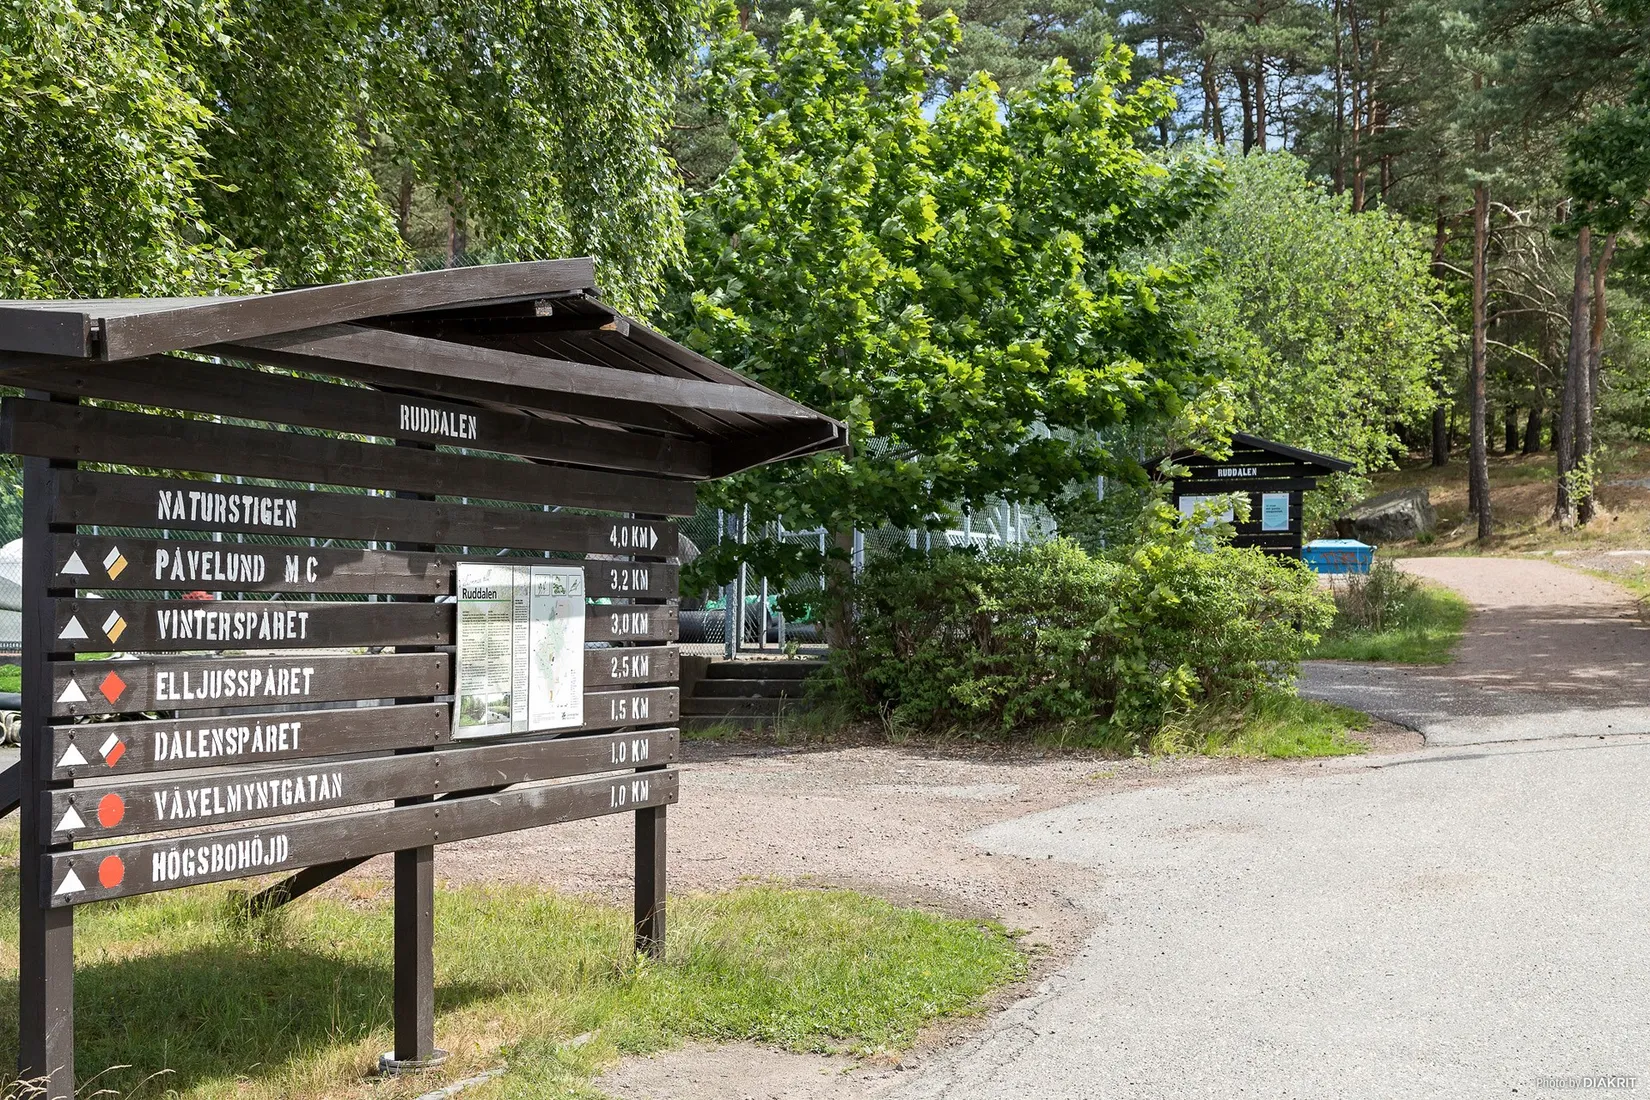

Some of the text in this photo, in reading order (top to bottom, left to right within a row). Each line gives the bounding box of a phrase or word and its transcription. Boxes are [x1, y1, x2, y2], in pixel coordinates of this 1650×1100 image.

[400, 404, 477, 440] RUDDALEN
[1217, 467, 1257, 477] RUDDALEN
[157, 490, 297, 528] NATURSTIGEN
[610, 525, 648, 548] 4,0 KM
[155, 547, 265, 582] PÅVELUND
[462, 587, 497, 599] Ruddalen
[610, 569, 648, 591] 3,2 KM
[157, 608, 309, 641] VINTERSPÅRET
[611, 612, 648, 635] 3,0 KM
[611, 655, 649, 678] 2,5 KM
[156, 664, 315, 700] ELLJUSSPÅRET
[611, 697, 649, 721] 1,5 KM
[154, 721, 301, 761] DALENSPÅRET
[611, 738, 649, 764] 1,0 KM
[610, 780, 649, 808] 1,0 KM
[152, 834, 288, 882] HÖGSBOHÖJD
